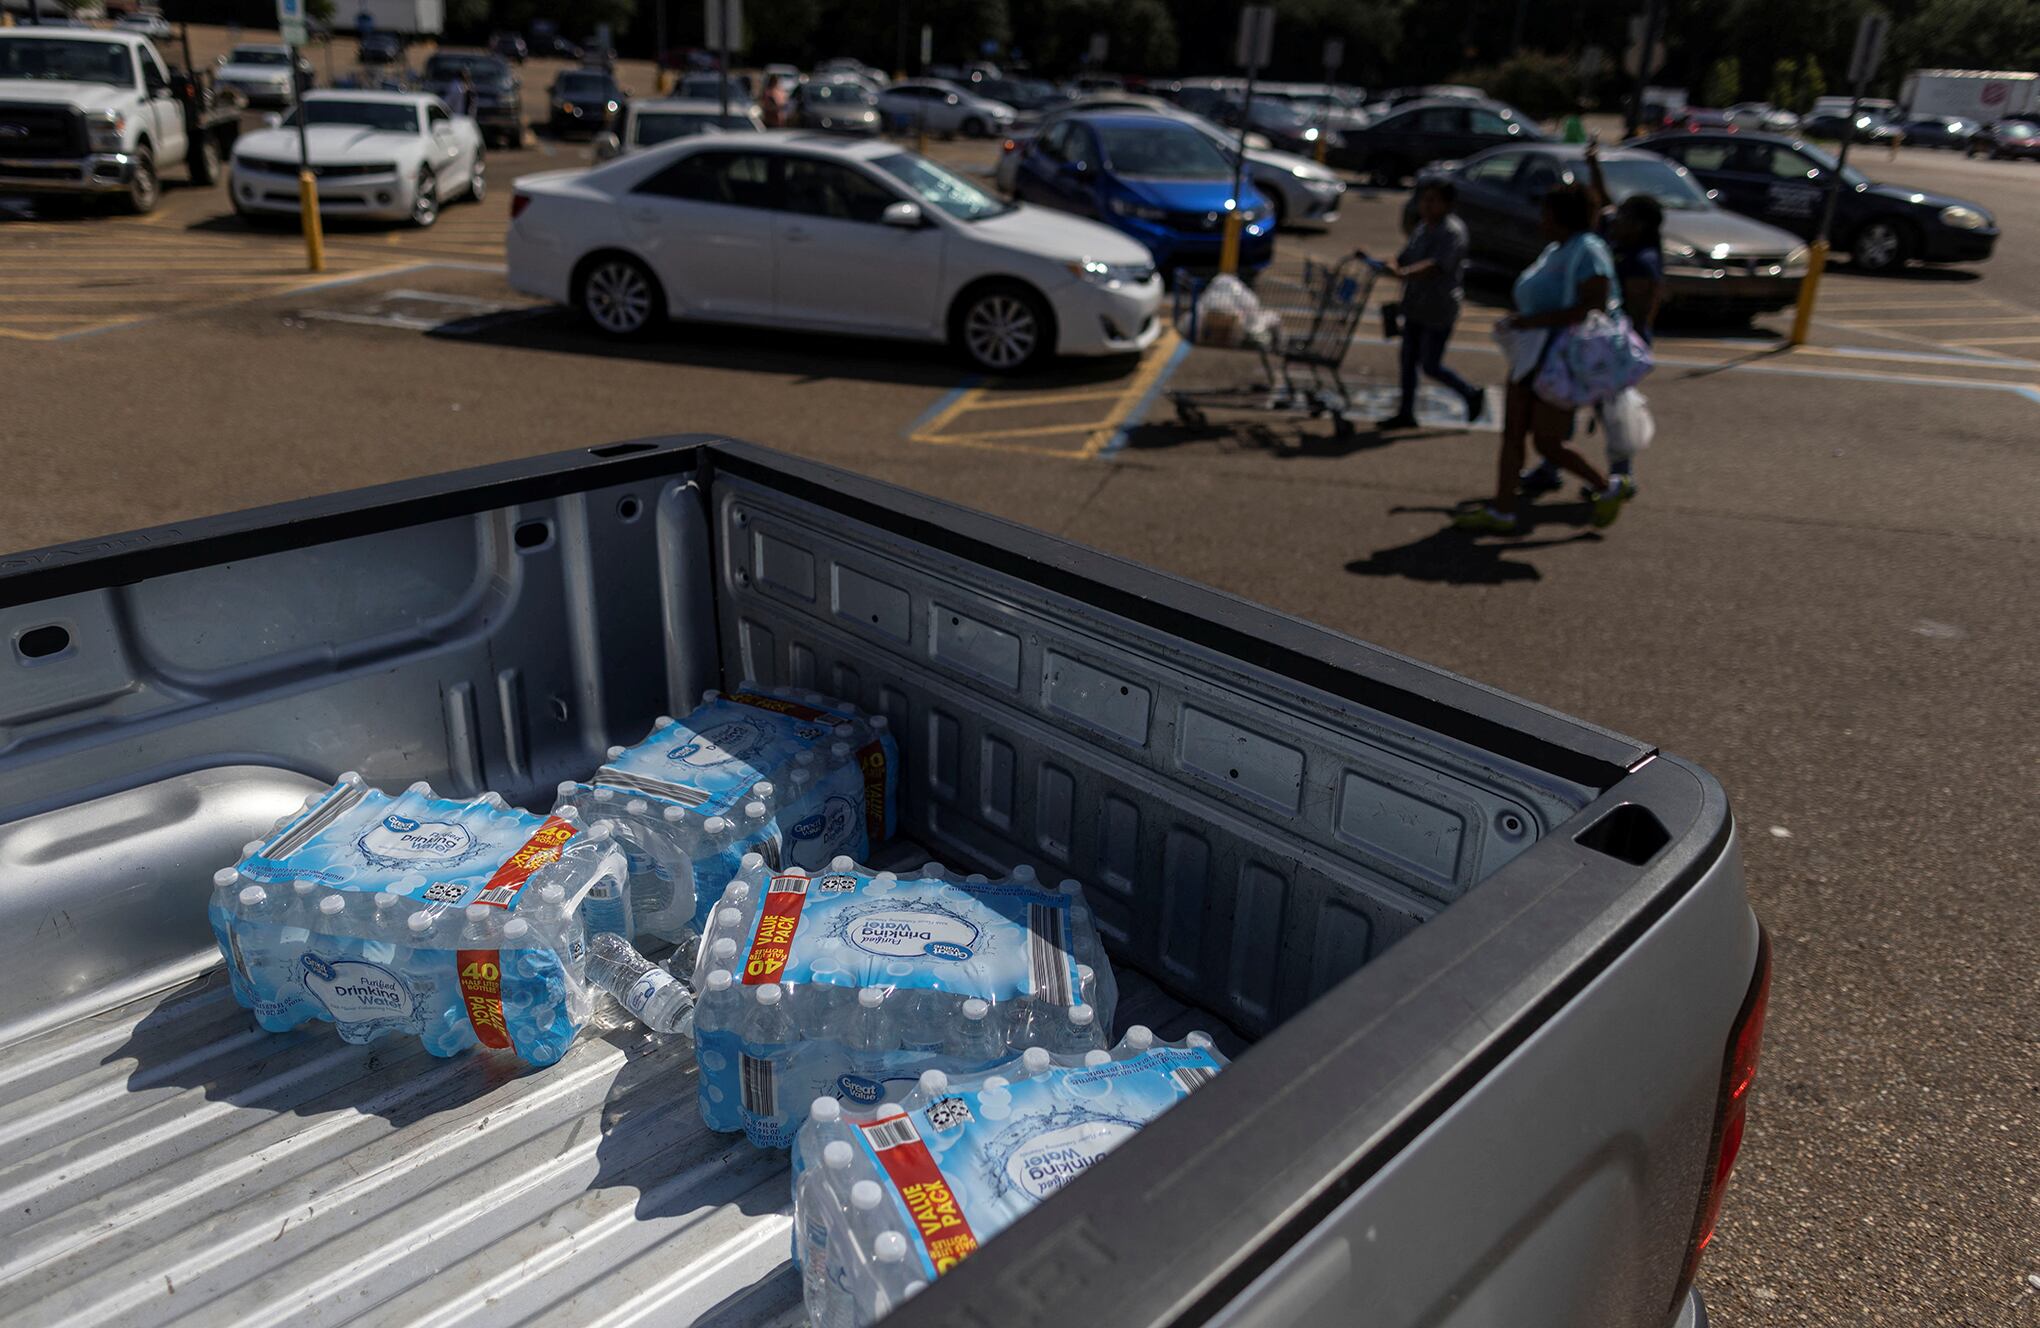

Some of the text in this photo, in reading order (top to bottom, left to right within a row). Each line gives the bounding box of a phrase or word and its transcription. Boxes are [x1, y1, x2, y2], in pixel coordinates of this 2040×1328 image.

[400, 834, 457, 849] Drinking
[538, 826, 572, 841] 40
[411, 841, 450, 854] Water
[756, 915, 779, 946] VALUE
[772, 915, 796, 944] PACK
[861, 927, 932, 941] Drinking
[862, 921, 912, 932] Water
[933, 947, 968, 960] Great
[462, 962, 499, 981] 40
[747, 957, 784, 976] 40
[360, 976, 397, 992] Purified
[334, 985, 400, 1003] Drinking
[357, 994, 402, 1009] Water
[468, 995, 492, 1026] PACK
[842, 1077, 877, 1095] Great
[850, 1087, 877, 1101] Value
[1023, 1147, 1081, 1169] Water
[902, 1183, 942, 1237] VALUE
[923, 1180, 962, 1228] PACK
